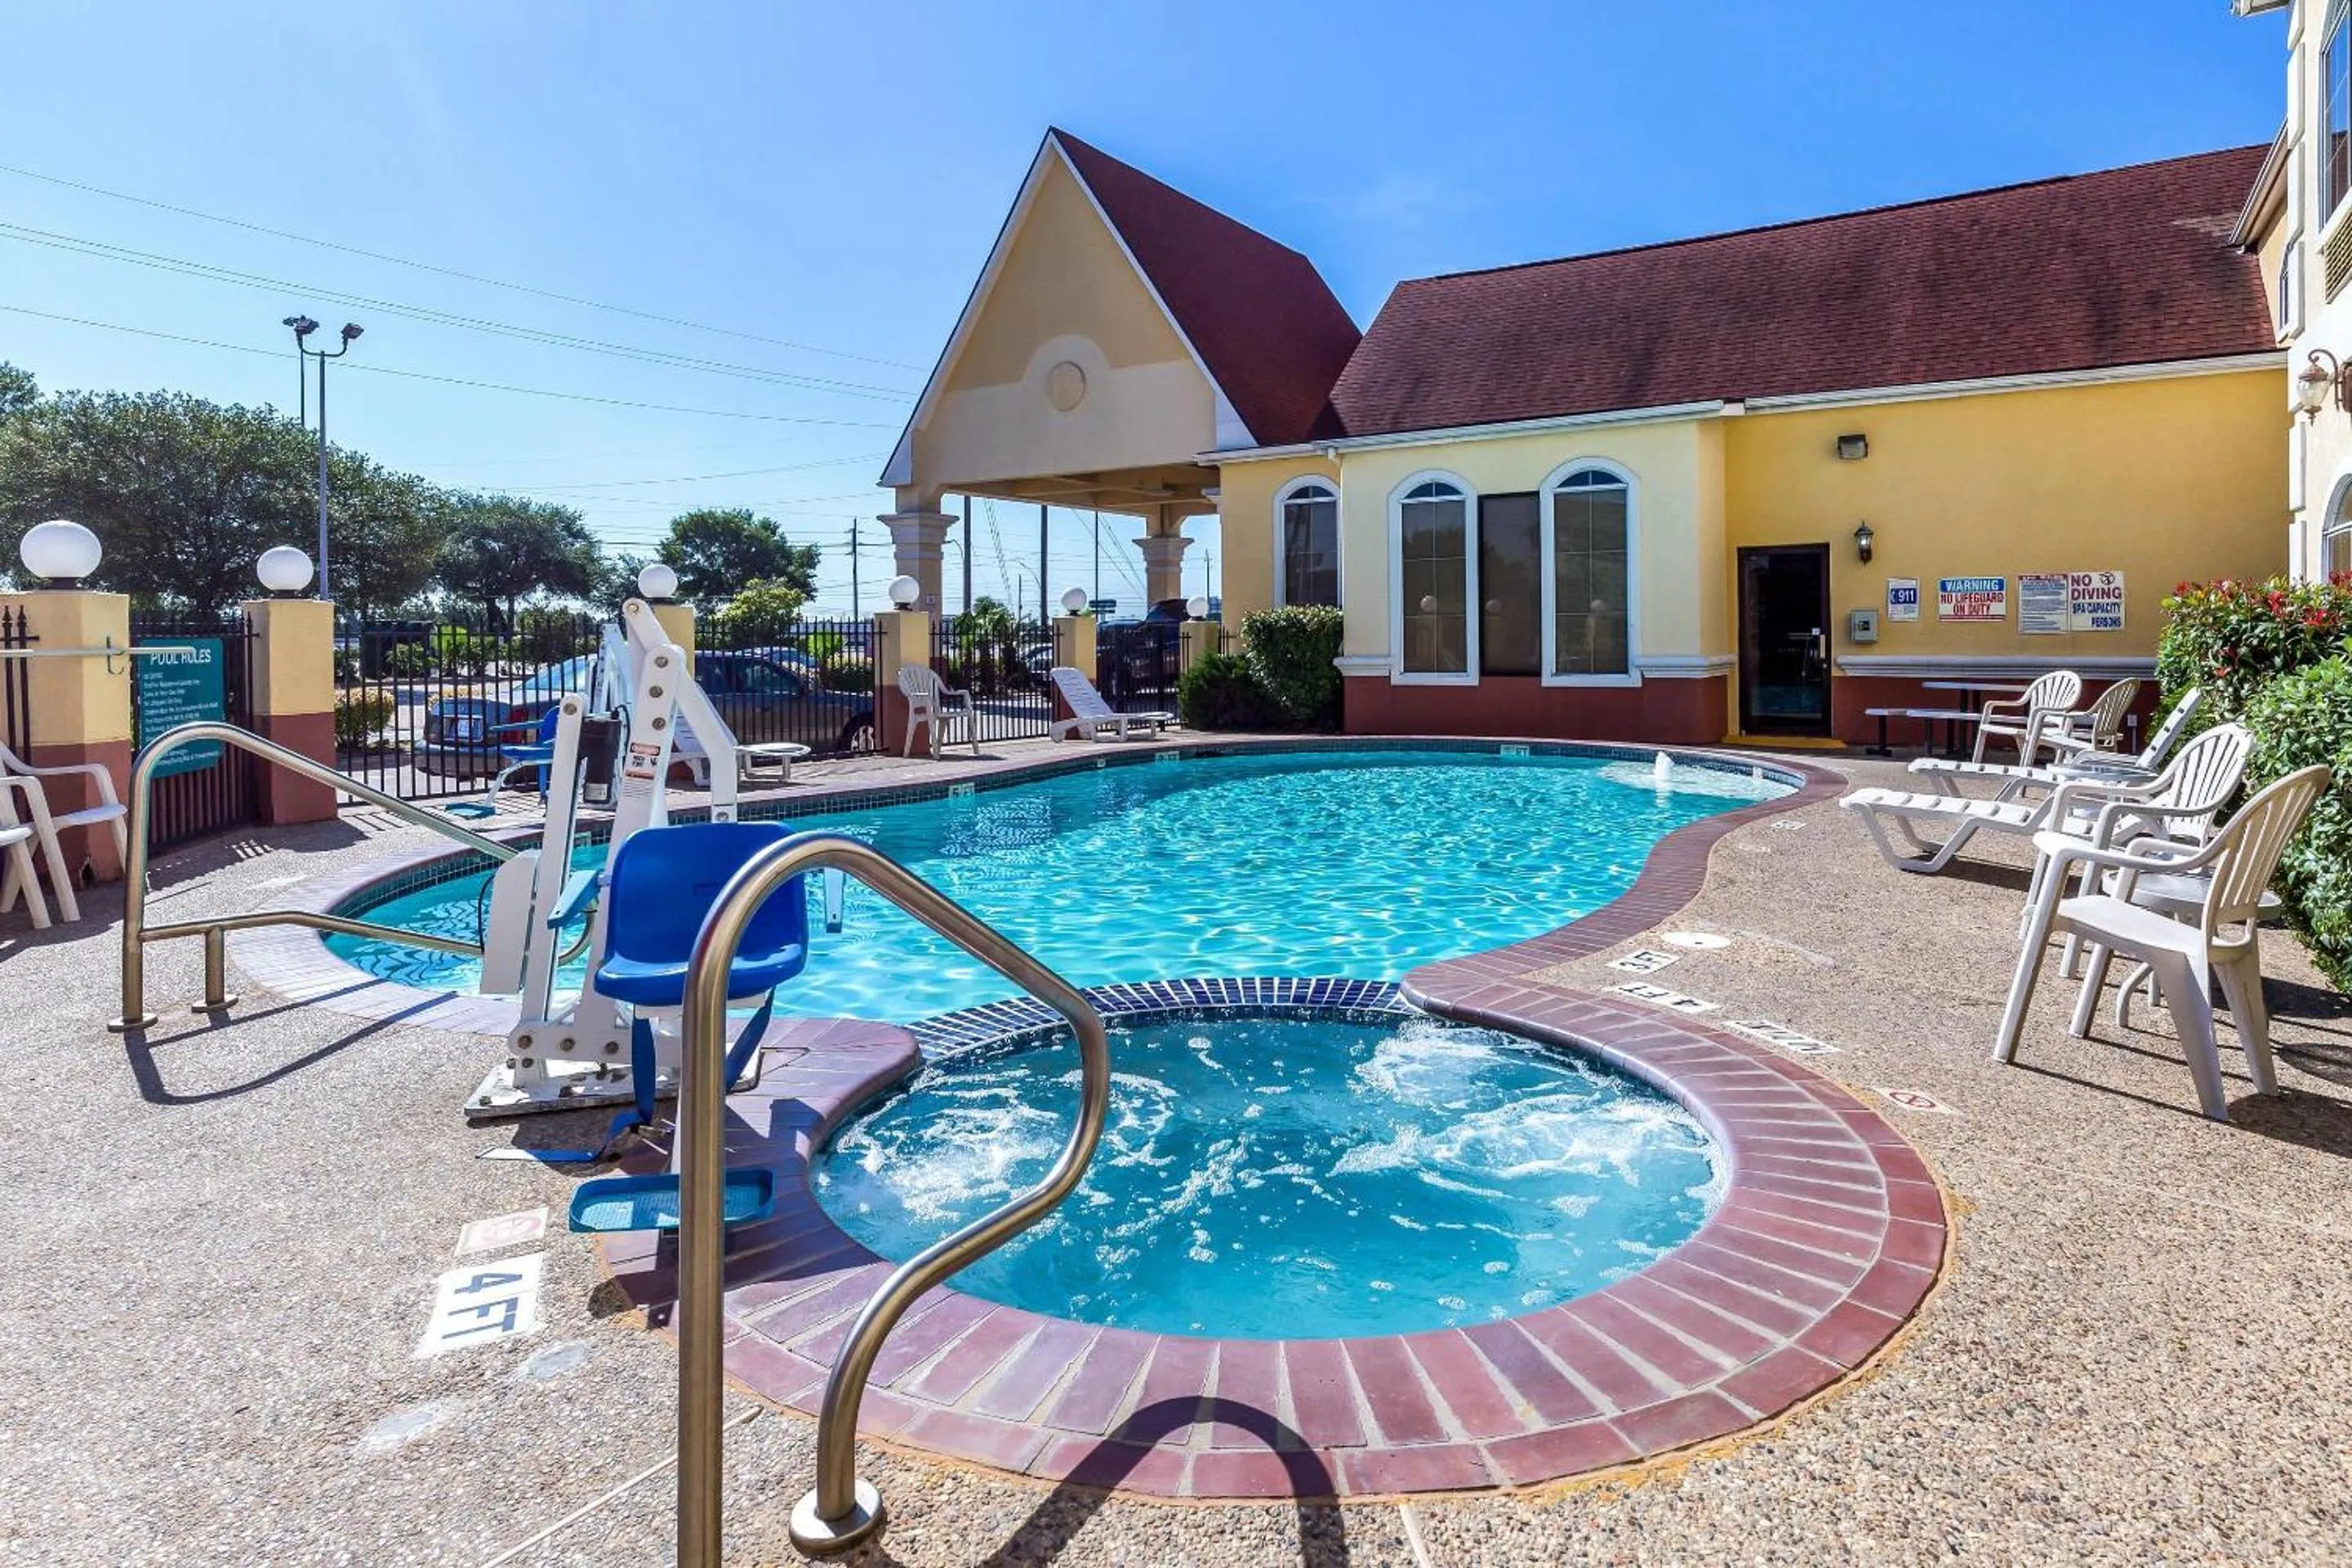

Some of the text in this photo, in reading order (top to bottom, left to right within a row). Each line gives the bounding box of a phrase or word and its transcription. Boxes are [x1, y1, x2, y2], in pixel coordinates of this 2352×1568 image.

[1944, 580, 1999, 592] WARNING
[2070, 573, 2092, 587] NO
[1898, 589, 1914, 603] 911
[1940, 592, 2004, 604] NO LIFEGUARD
[2070, 586, 2123, 600] DIVING
[1953, 603, 1991, 615] ON DUTY
[2072, 602, 2121, 614] SPA CAPACITY
[150, 651, 180, 666] POOL
